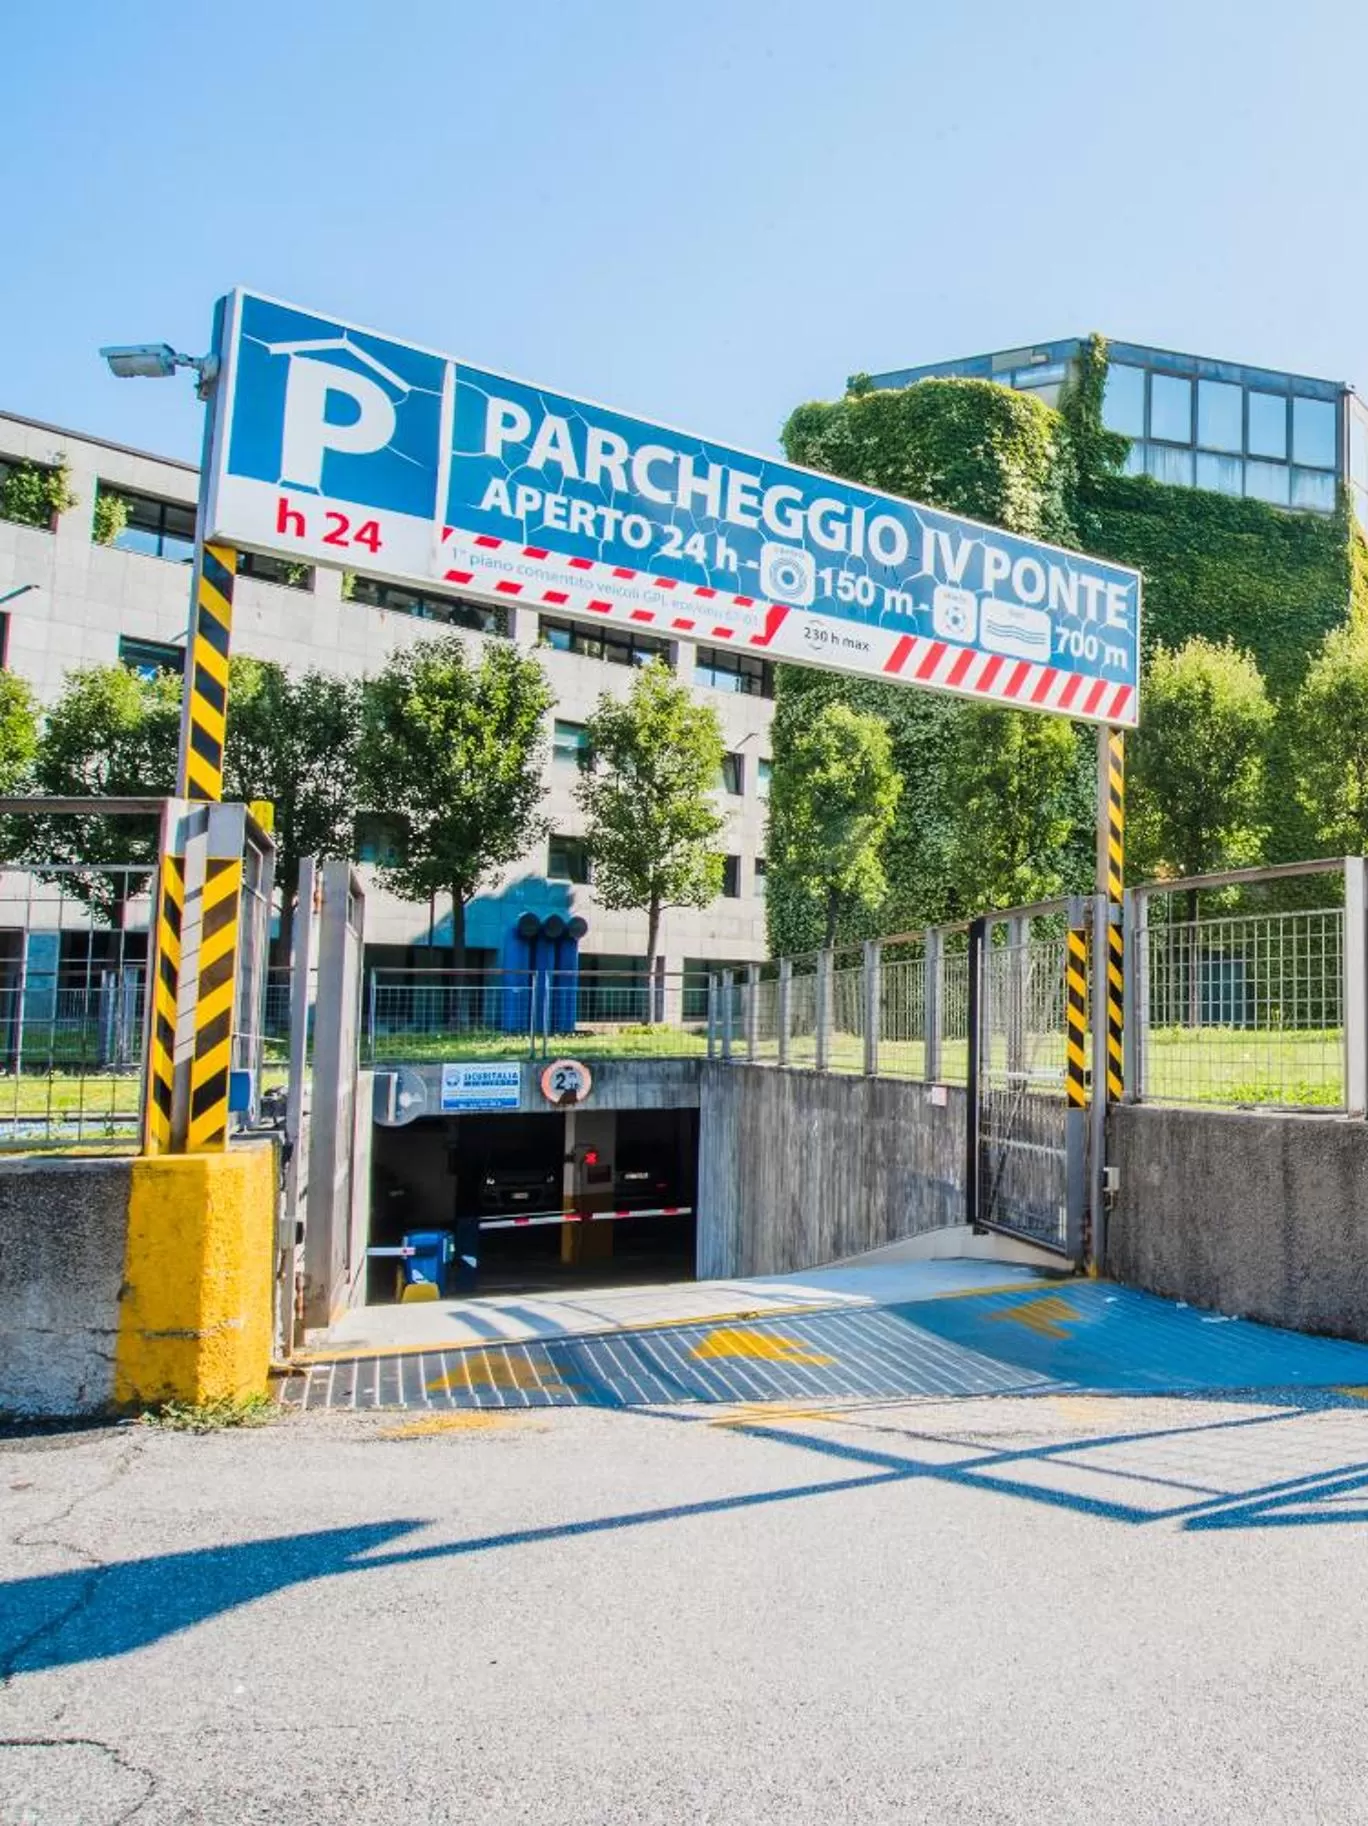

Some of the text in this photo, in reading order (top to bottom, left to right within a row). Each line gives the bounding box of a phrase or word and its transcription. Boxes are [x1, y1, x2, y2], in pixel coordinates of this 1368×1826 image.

[281, 354, 397, 489] P
[276, 498, 383, 553] h 24
[484, 396, 1128, 629] PARCHEGGIO IV PONTE
[470, 554, 513, 572] piano
[480, 477, 652, 549] APERTO
[661, 524, 709, 564] 24
[716, 535, 737, 572] h
[817, 567, 875, 606] 150
[884, 588, 913, 614] m
[1055, 626, 1098, 661] 700
[1105, 644, 1128, 672] m
[803, 626, 828, 643] 230
[842, 636, 871, 651] max
